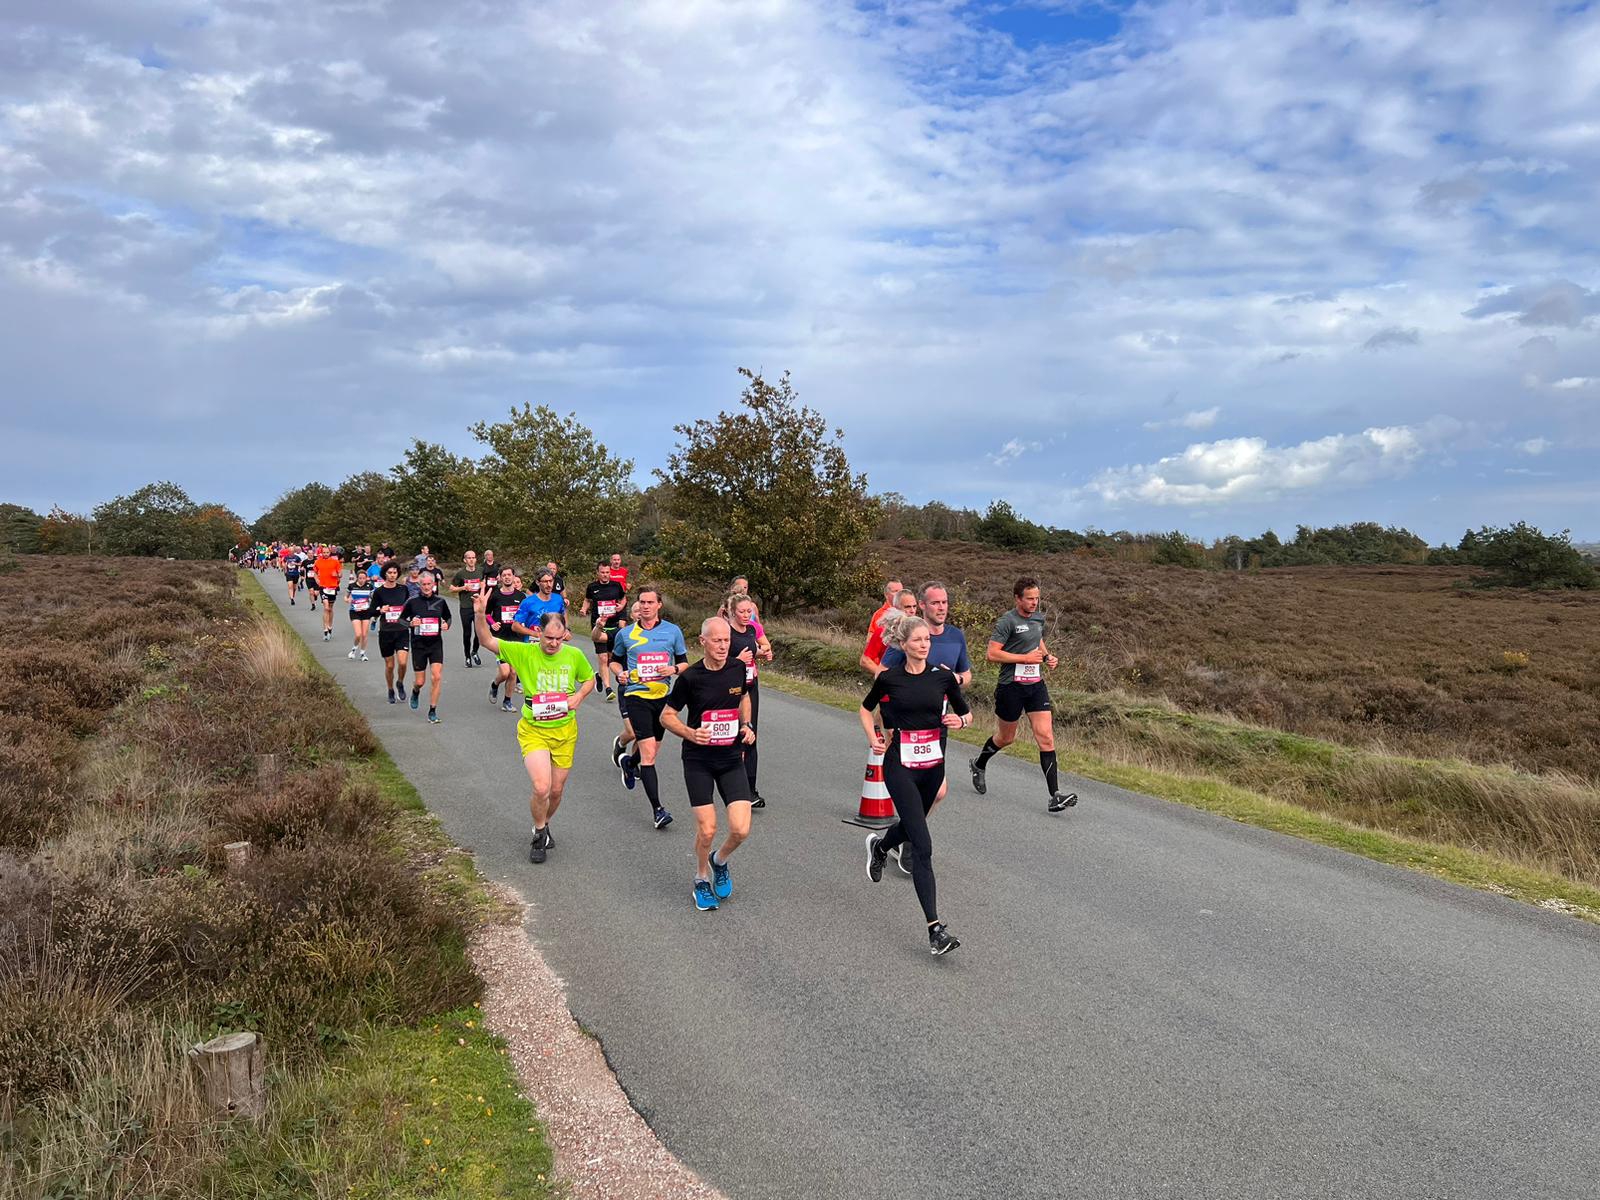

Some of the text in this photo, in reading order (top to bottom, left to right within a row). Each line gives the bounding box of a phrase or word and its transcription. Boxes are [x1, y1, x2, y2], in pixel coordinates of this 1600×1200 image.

[545, 703, 556, 711] 49
[712, 722, 730, 732] 600
[913, 744, 932, 754] 836
